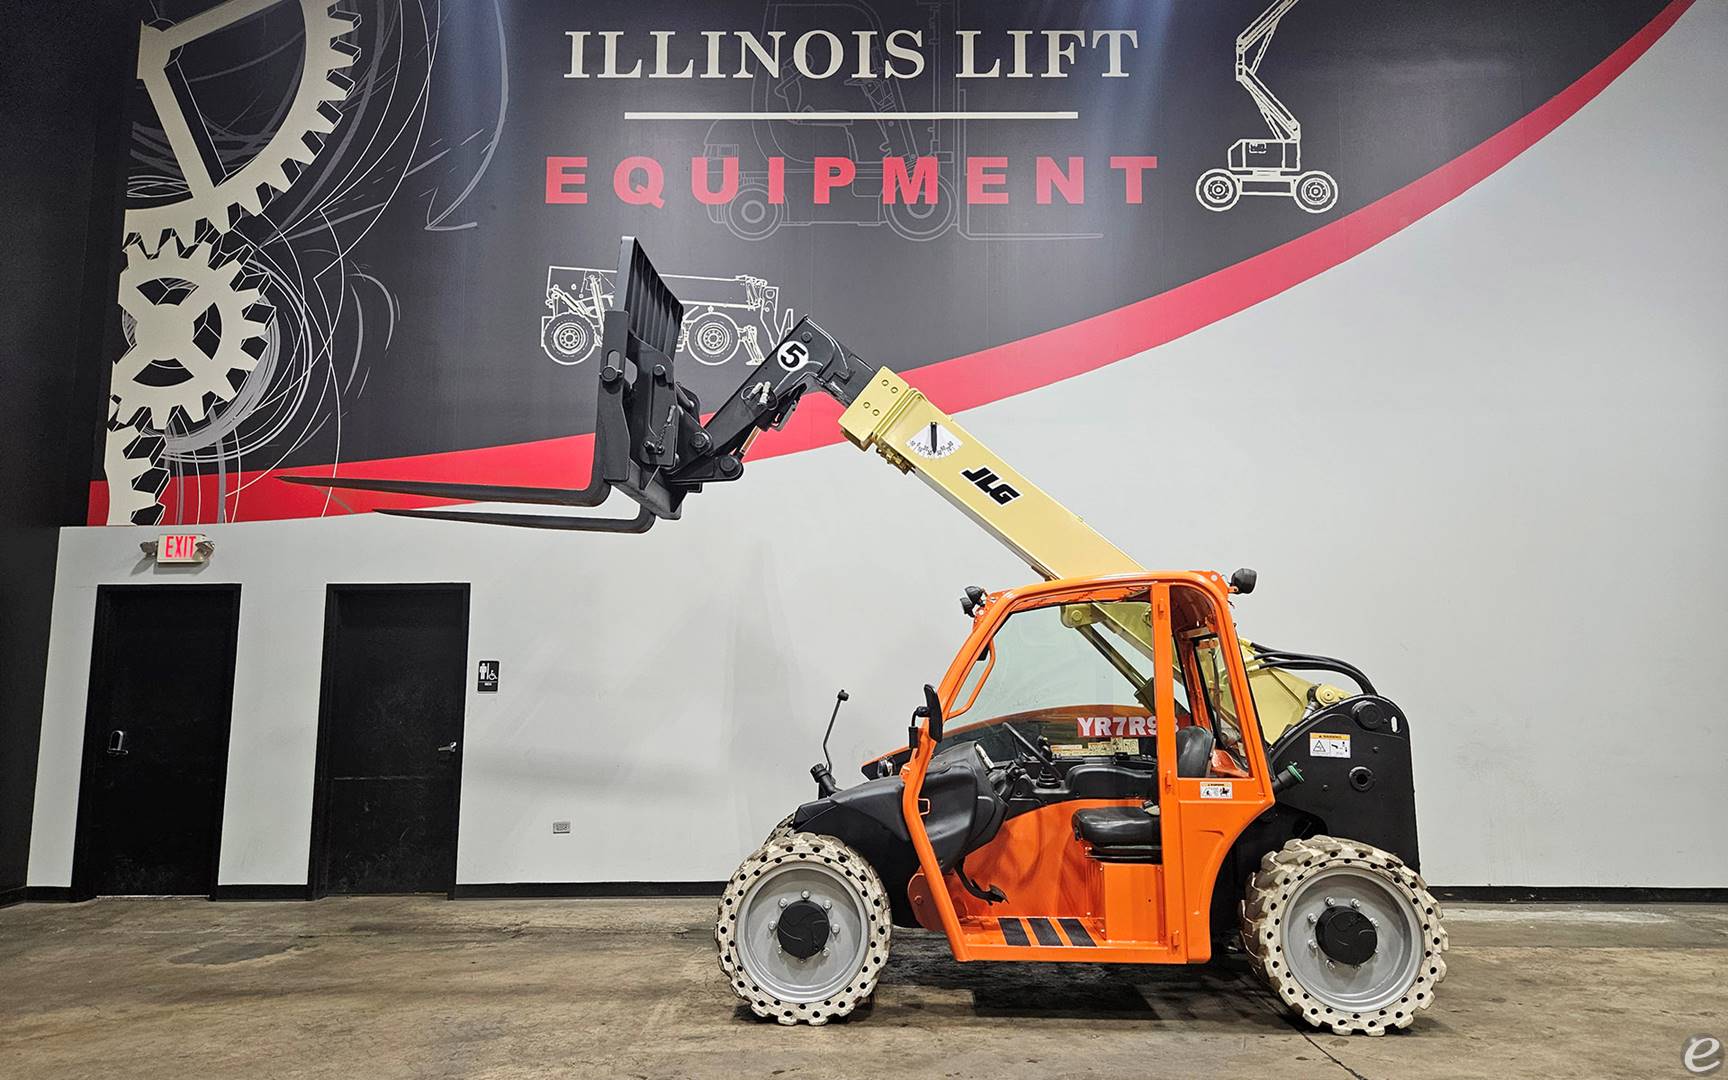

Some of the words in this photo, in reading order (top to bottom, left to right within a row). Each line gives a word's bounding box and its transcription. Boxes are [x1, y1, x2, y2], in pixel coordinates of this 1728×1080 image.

[563, 30, 925, 80] ILLINOIS
[956, 30, 1138, 79] LIFT
[545, 155, 1159, 209] EQUIPMENT
[780, 343, 807, 368] 5
[960, 466, 1021, 506] JLG
[165, 535, 197, 559] EXIT
[1077, 717, 1179, 736] YR7R9
